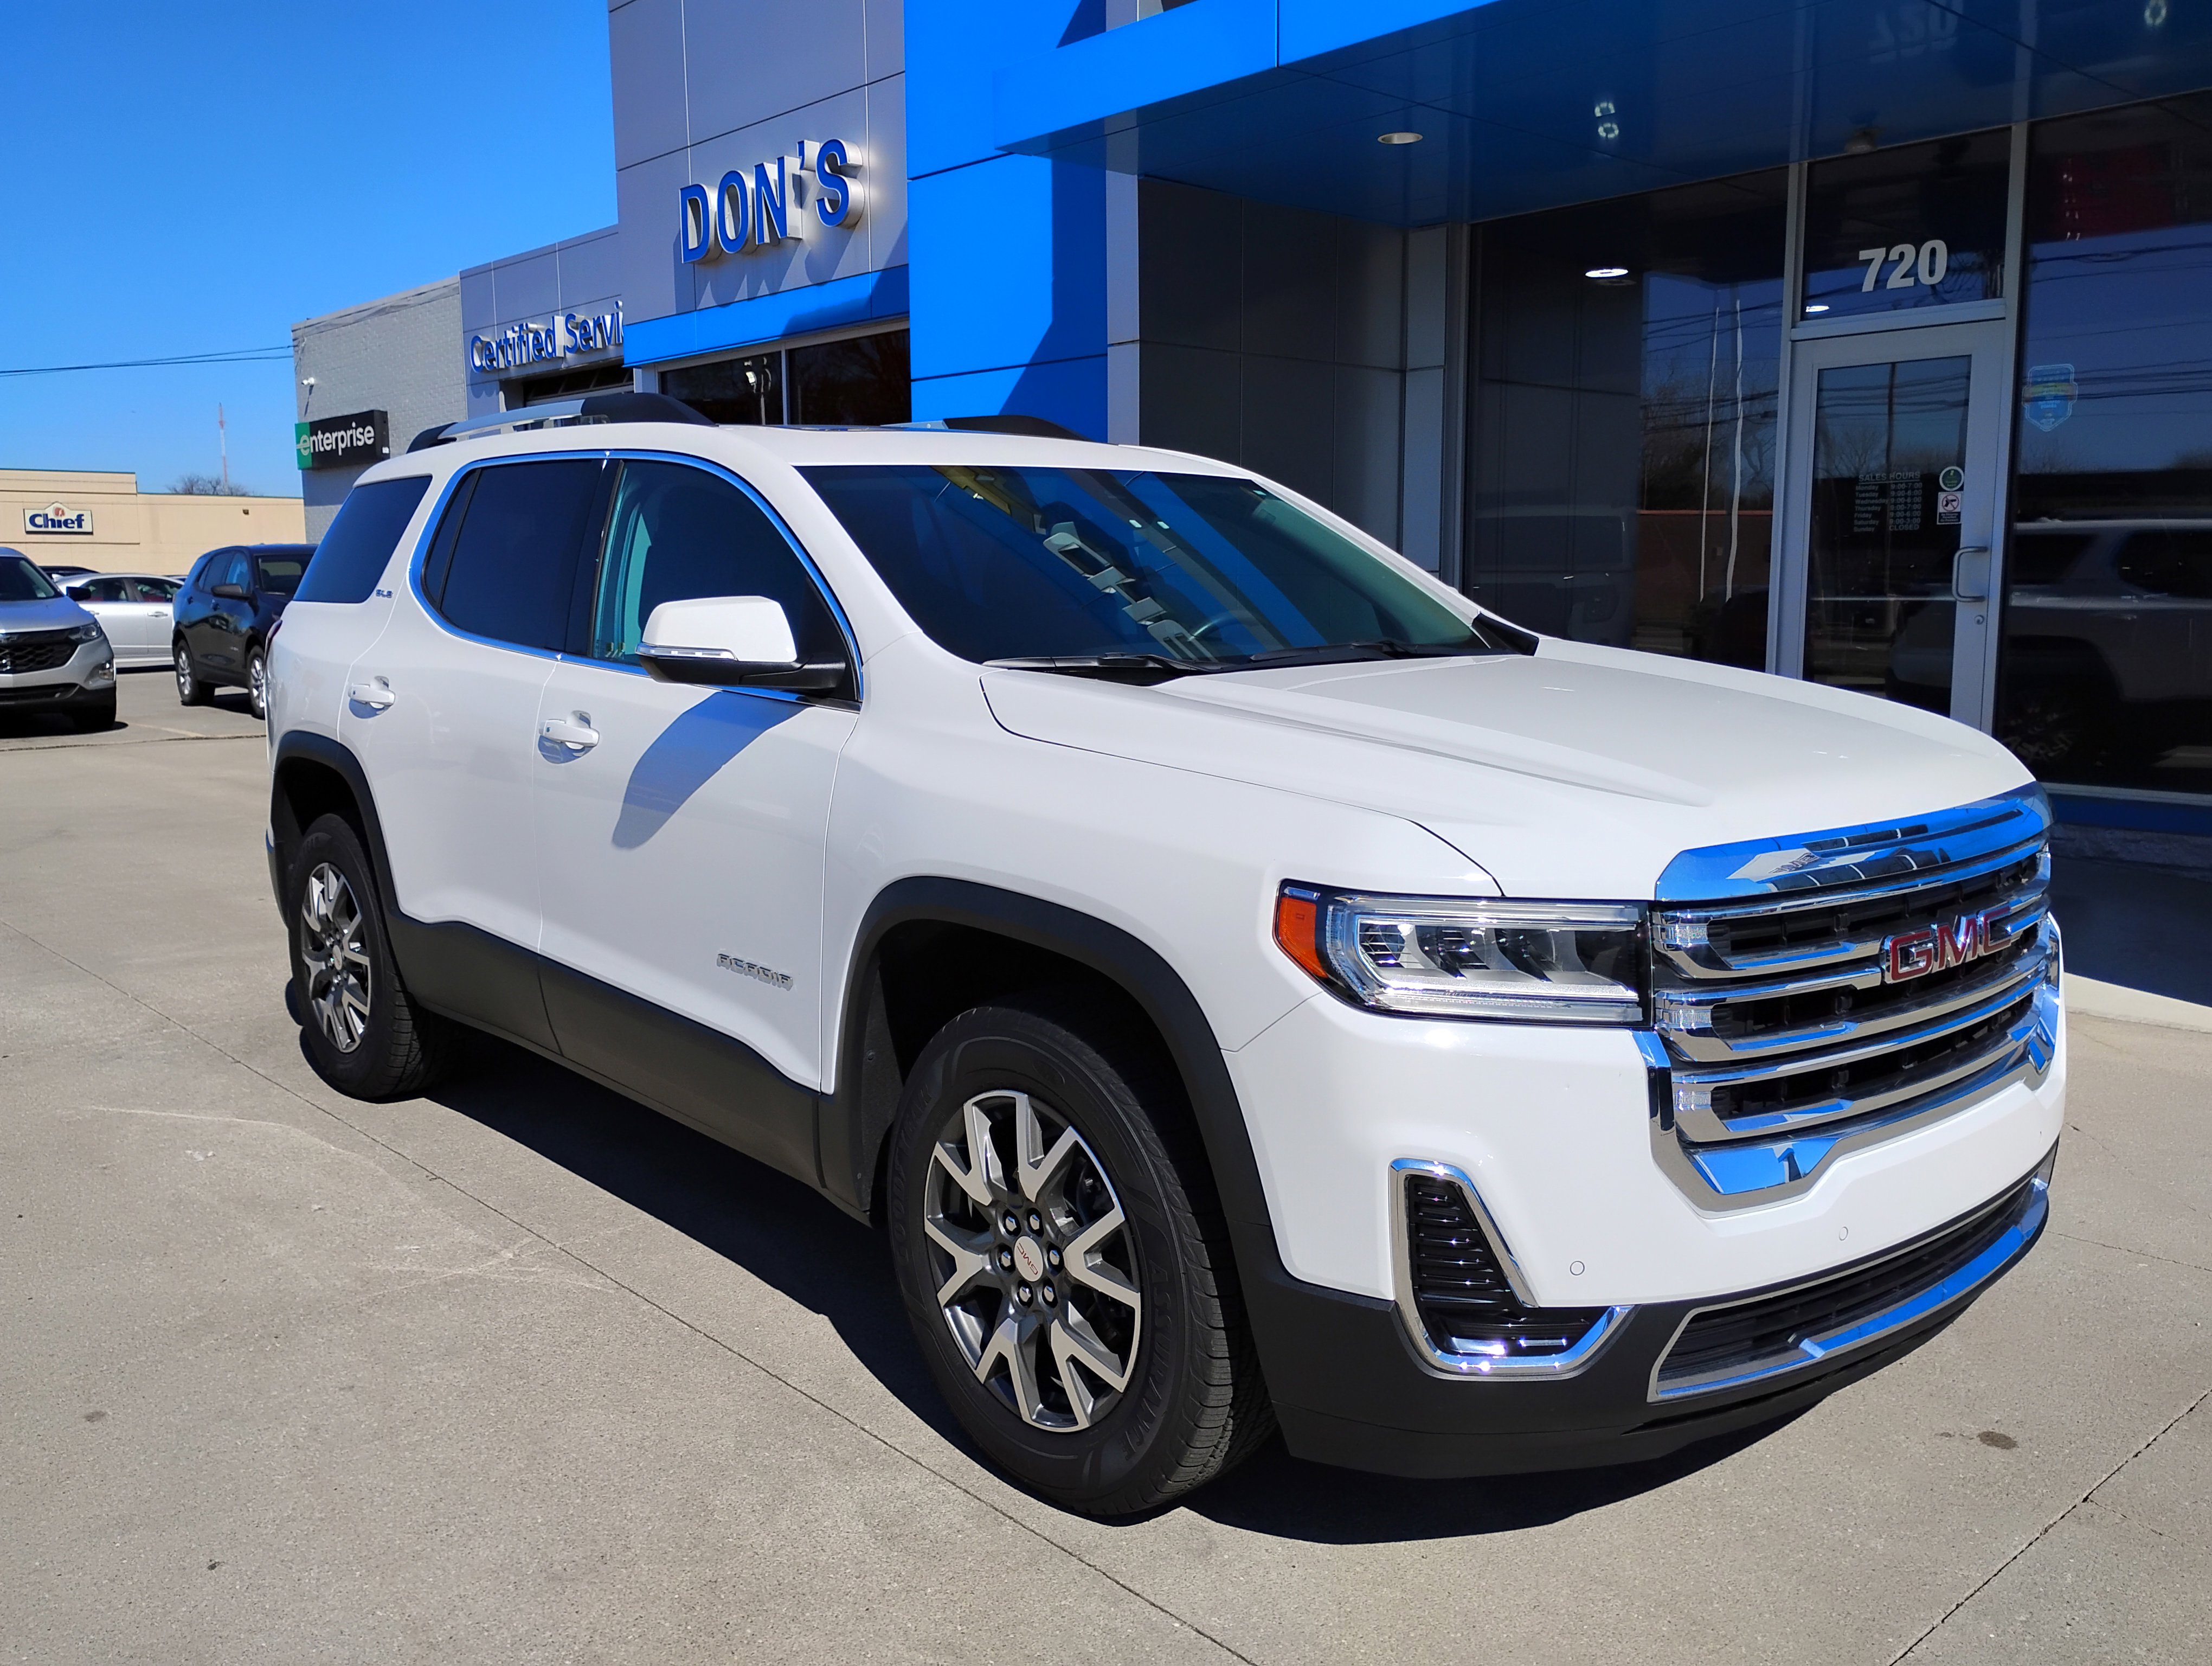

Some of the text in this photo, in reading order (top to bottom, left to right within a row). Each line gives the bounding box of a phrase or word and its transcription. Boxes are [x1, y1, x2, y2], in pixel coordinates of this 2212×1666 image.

[679, 139, 865, 264] DON'S
[1859, 240, 1947, 292] 720
[470, 300, 624, 373] Certified Servi
[296, 421, 375, 456] enterprise
[1858, 471, 1920, 482] SALES HOURS
[29, 514, 85, 529] Chief
[1885, 905, 2012, 983] GMC
[1017, 1242, 1038, 1276] GMC
